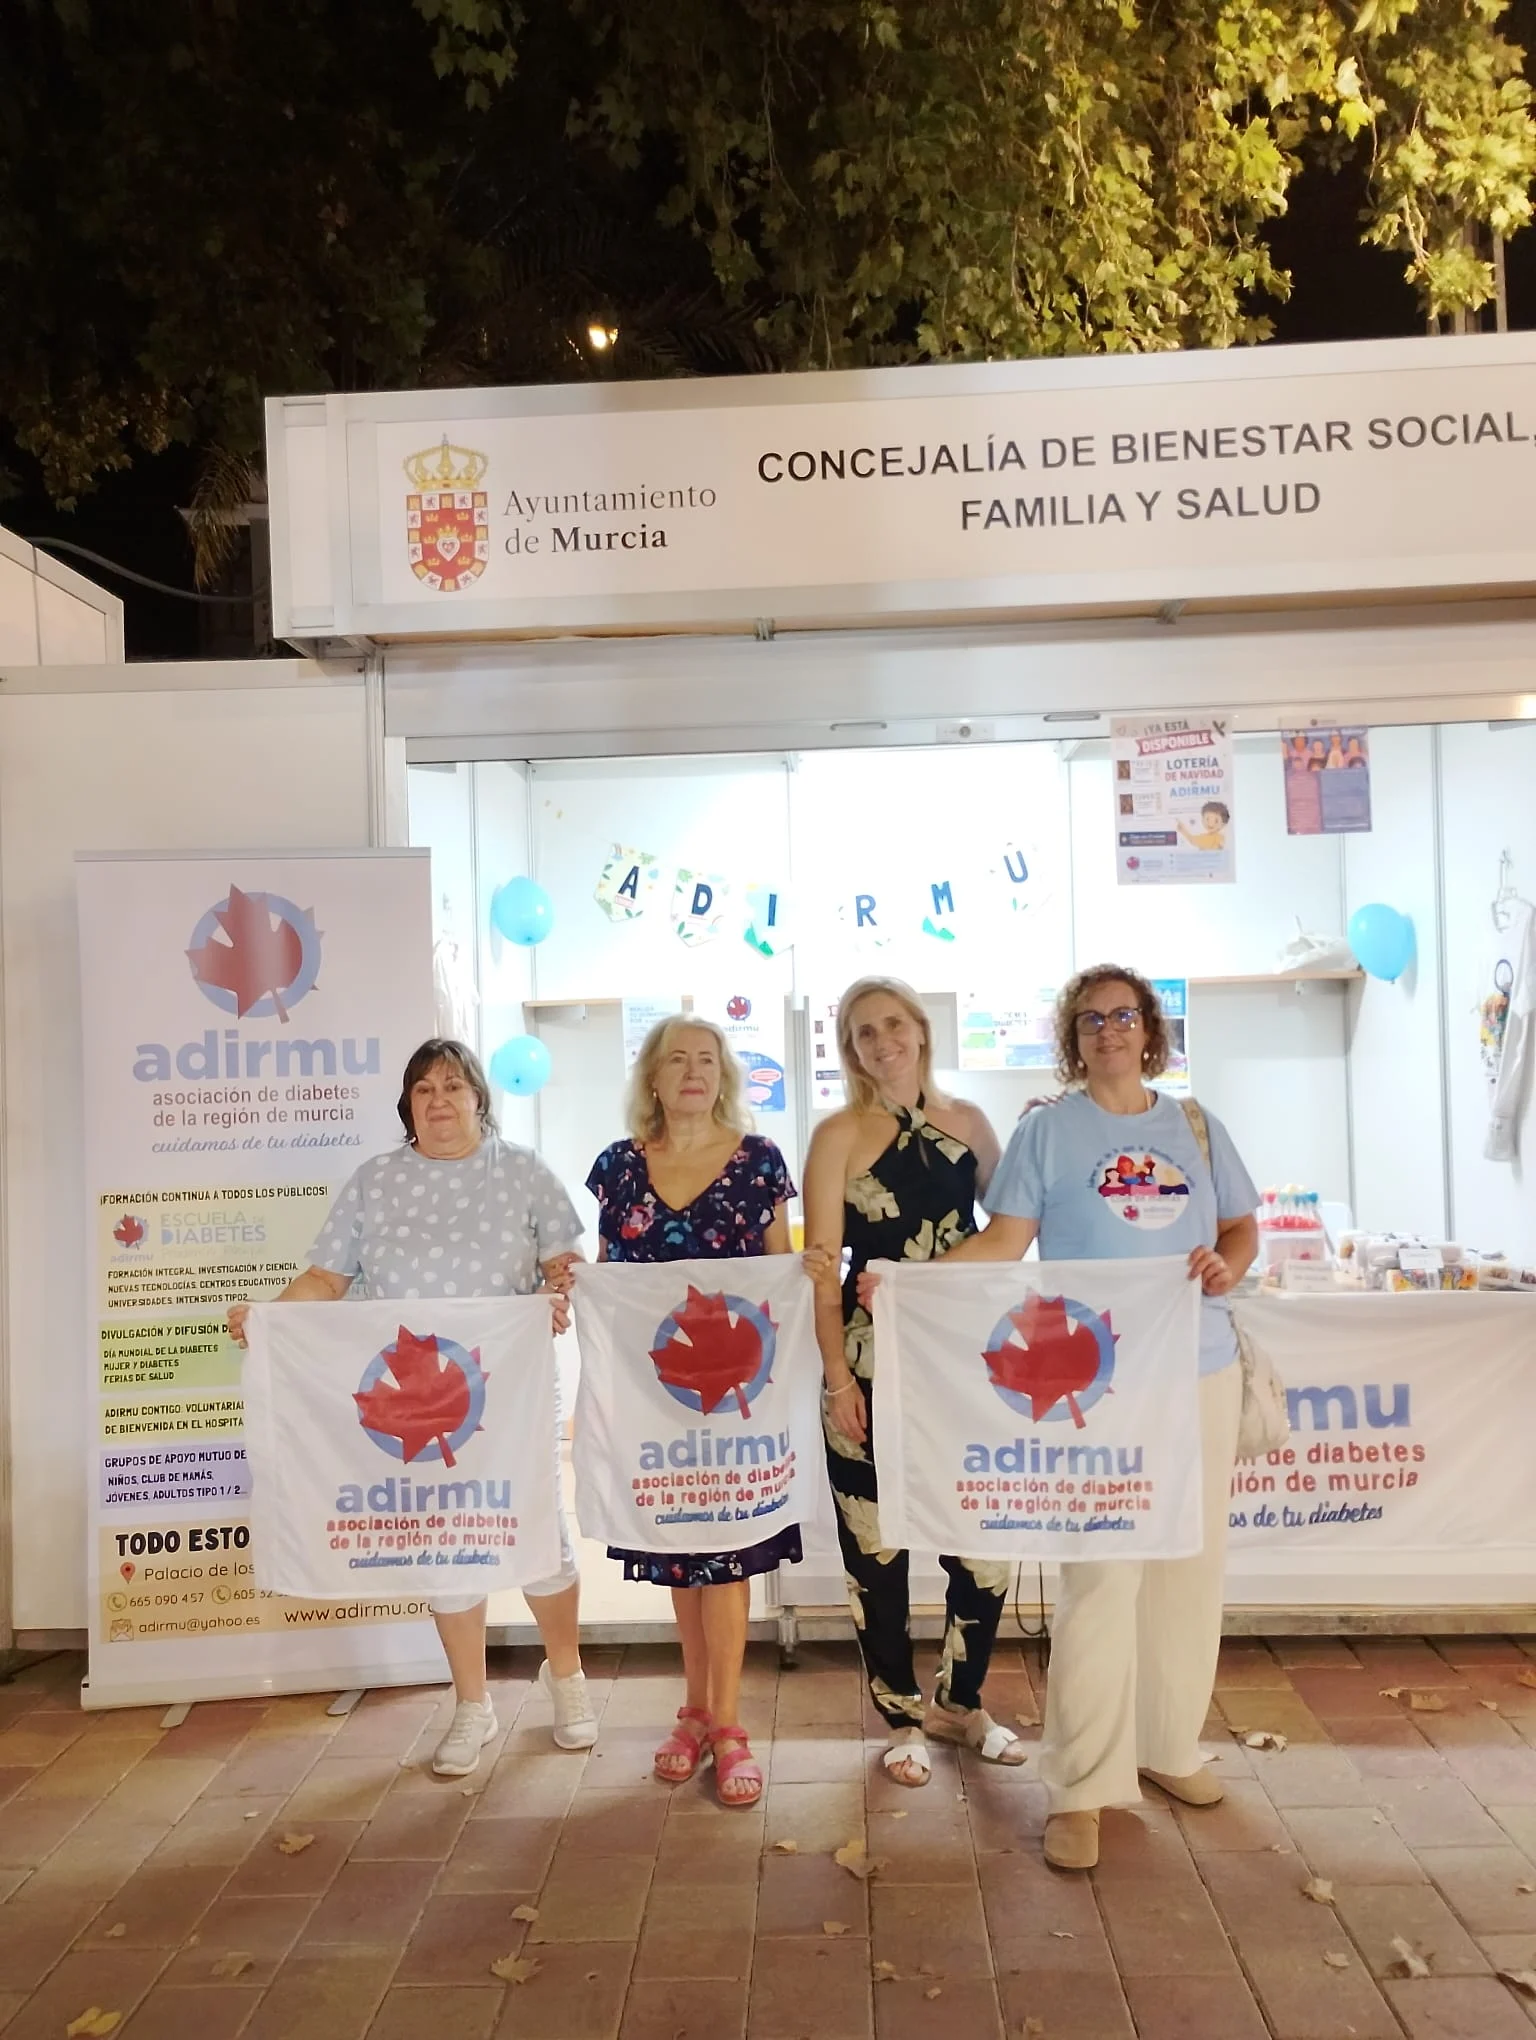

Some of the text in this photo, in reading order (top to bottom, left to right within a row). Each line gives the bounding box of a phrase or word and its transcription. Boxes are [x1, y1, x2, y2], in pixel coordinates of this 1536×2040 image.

[758, 433, 1026, 483] CONCEJALÍA
[1041, 436, 1096, 468] DE
[1112, 420, 1353, 464] BIENESTAR
[503, 484, 716, 522] Ayuntamiento
[961, 482, 1321, 530] FAMILIA Y SALUD
[505, 524, 668, 555] de Murcia
[1164, 719, 1190, 732] ESTÁ
[1141, 731, 1210, 753] DISPONIBLE
[1166, 755, 1219, 770] LOTERÍA
[1165, 771, 1177, 782] DE
[1179, 769, 1224, 782] NAVIDAD
[1169, 785, 1221, 798] ADIRMU
[132, 1029, 381, 1083] adirmu
[152, 1084, 361, 1106] asociación de diabetes
[153, 1104, 354, 1129] de la región de murcia
[151, 1133, 363, 1154] cuidamos de tu diabetes
[100, 1192, 158, 1205] ¡FORMACIÓN
[162, 1190, 211, 1202] CONTINUA
[213, 1190, 219, 1200] A
[222, 1188, 253, 1200] TODOS
[256, 1187, 275, 1198] LOS
[160, 1211, 247, 1226] ESCUELA
[161, 1224, 266, 1245] DIABETES
[110, 1253, 154, 1264] adirmu
[108, 1268, 153, 1279] FORMACIÓN
[198, 1263, 257, 1274] INVESTIGACIÓN
[260, 1263, 264, 1272] Y
[108, 1284, 139, 1294] NUEVAS
[200, 1280, 236, 1289] CENTROS
[238, 1277, 286, 1287] EDUCATIVOS
[176, 1294, 222, 1304] INTENSIVOS
[101, 1326, 163, 1340] DIVULGACIÓN
[166, 1326, 173, 1336] Y
[175, 1323, 219, 1336] DIFUSIÓN
[104, 1344, 219, 1359] DÍA MUNDIAL DE LA DIABETES
[104, 1359, 180, 1371] MUJER Y DIABETES
[104, 1372, 175, 1384] FERIAS DE SALUD
[105, 1407, 138, 1418] ADIRMU
[105, 1425, 117, 1434] DE
[119, 1421, 174, 1433] BIENVENIDA
[177, 1420, 188, 1429] EN
[191, 1419, 203, 1428] EL
[639, 1424, 791, 1471] adirmu
[1307, 1441, 1426, 1464] diabetes
[105, 1450, 247, 1468] GRUPOS DE APOYO MUTUO DE
[963, 1438, 1143, 1476] adirmu
[141, 1474, 165, 1484] CLUB
[168, 1473, 180, 1482] DE
[632, 1469, 720, 1490] asociación
[725, 1469, 741, 1485] de
[956, 1478, 1154, 1496] asociación de diabetes
[1286, 1470, 1317, 1492] de
[1328, 1467, 1419, 1492] murcia
[153, 1488, 194, 1500] ADULTOS
[196, 1487, 217, 1497] TIPO
[220, 1486, 225, 1495] 1
[335, 1477, 511, 1513] adirmu
[636, 1490, 655, 1507] de
[661, 1490, 674, 1505] la
[681, 1488, 730, 1507] región
[736, 1487, 754, 1501] de
[961, 1495, 1152, 1514] de la región de murcia
[326, 1512, 518, 1532] asociación de diabetes
[718, 1506, 733, 1522] de
[1253, 1504, 1278, 1528] de
[1282, 1505, 1306, 1528] tu
[1308, 1500, 1383, 1525] diabetes
[1046, 1516, 1064, 1533] de
[1065, 1516, 1080, 1533] tu
[115, 1525, 250, 1557] TODO ESTO
[330, 1531, 516, 1551] de la región de murcia
[417, 1550, 433, 1566] de
[435, 1551, 450, 1566] tu
[144, 1565, 203, 1582] Palacio
[208, 1563, 229, 1579] de
[129, 1597, 151, 1608] 665
[155, 1594, 178, 1606] 090
[182, 1592, 204, 1604] 457
[233, 1589, 256, 1600] 605
[138, 1615, 261, 1633] adirmu@yahoo.es
